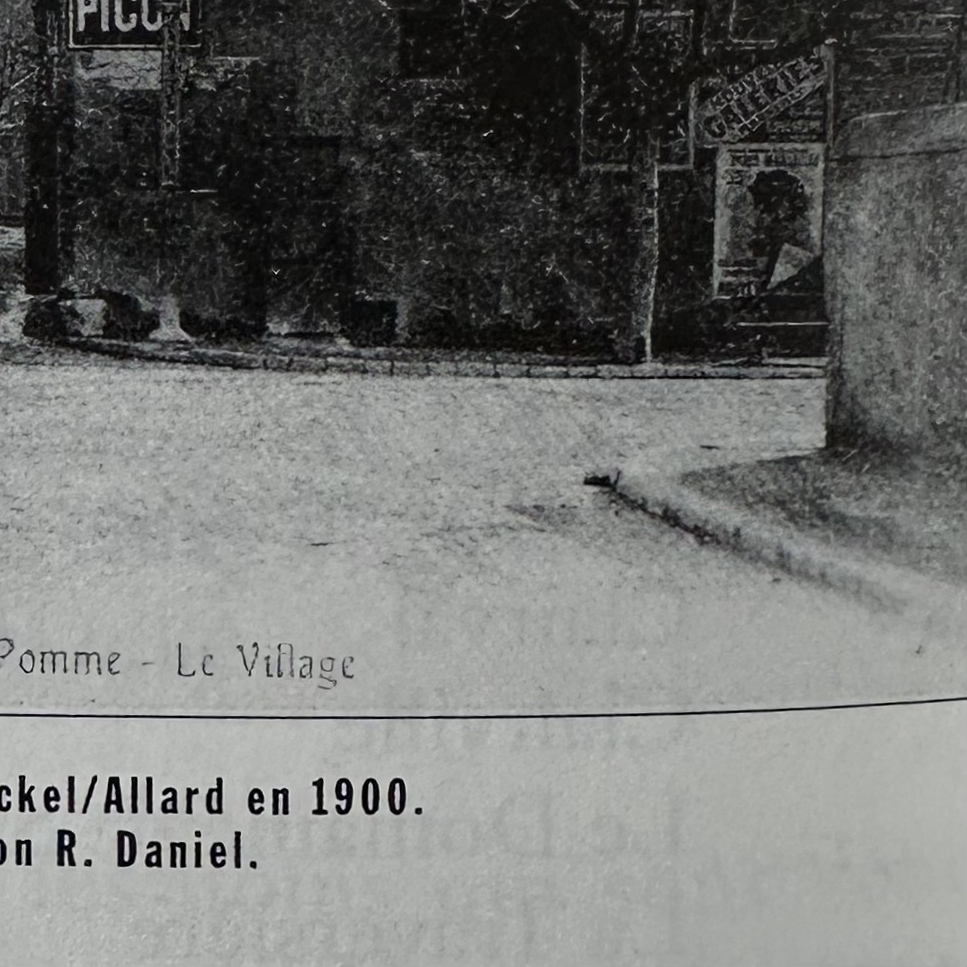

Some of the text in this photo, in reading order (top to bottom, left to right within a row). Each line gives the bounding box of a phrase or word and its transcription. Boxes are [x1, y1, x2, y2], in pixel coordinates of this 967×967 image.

[177, 642, 214, 678] Le
[236, 641, 355, 690] Village
[247, 787, 290, 816] en
[311, 777, 423, 816] 1900.
[56, 829, 93, 867] R.
[116, 829, 257, 870] Daniel.
